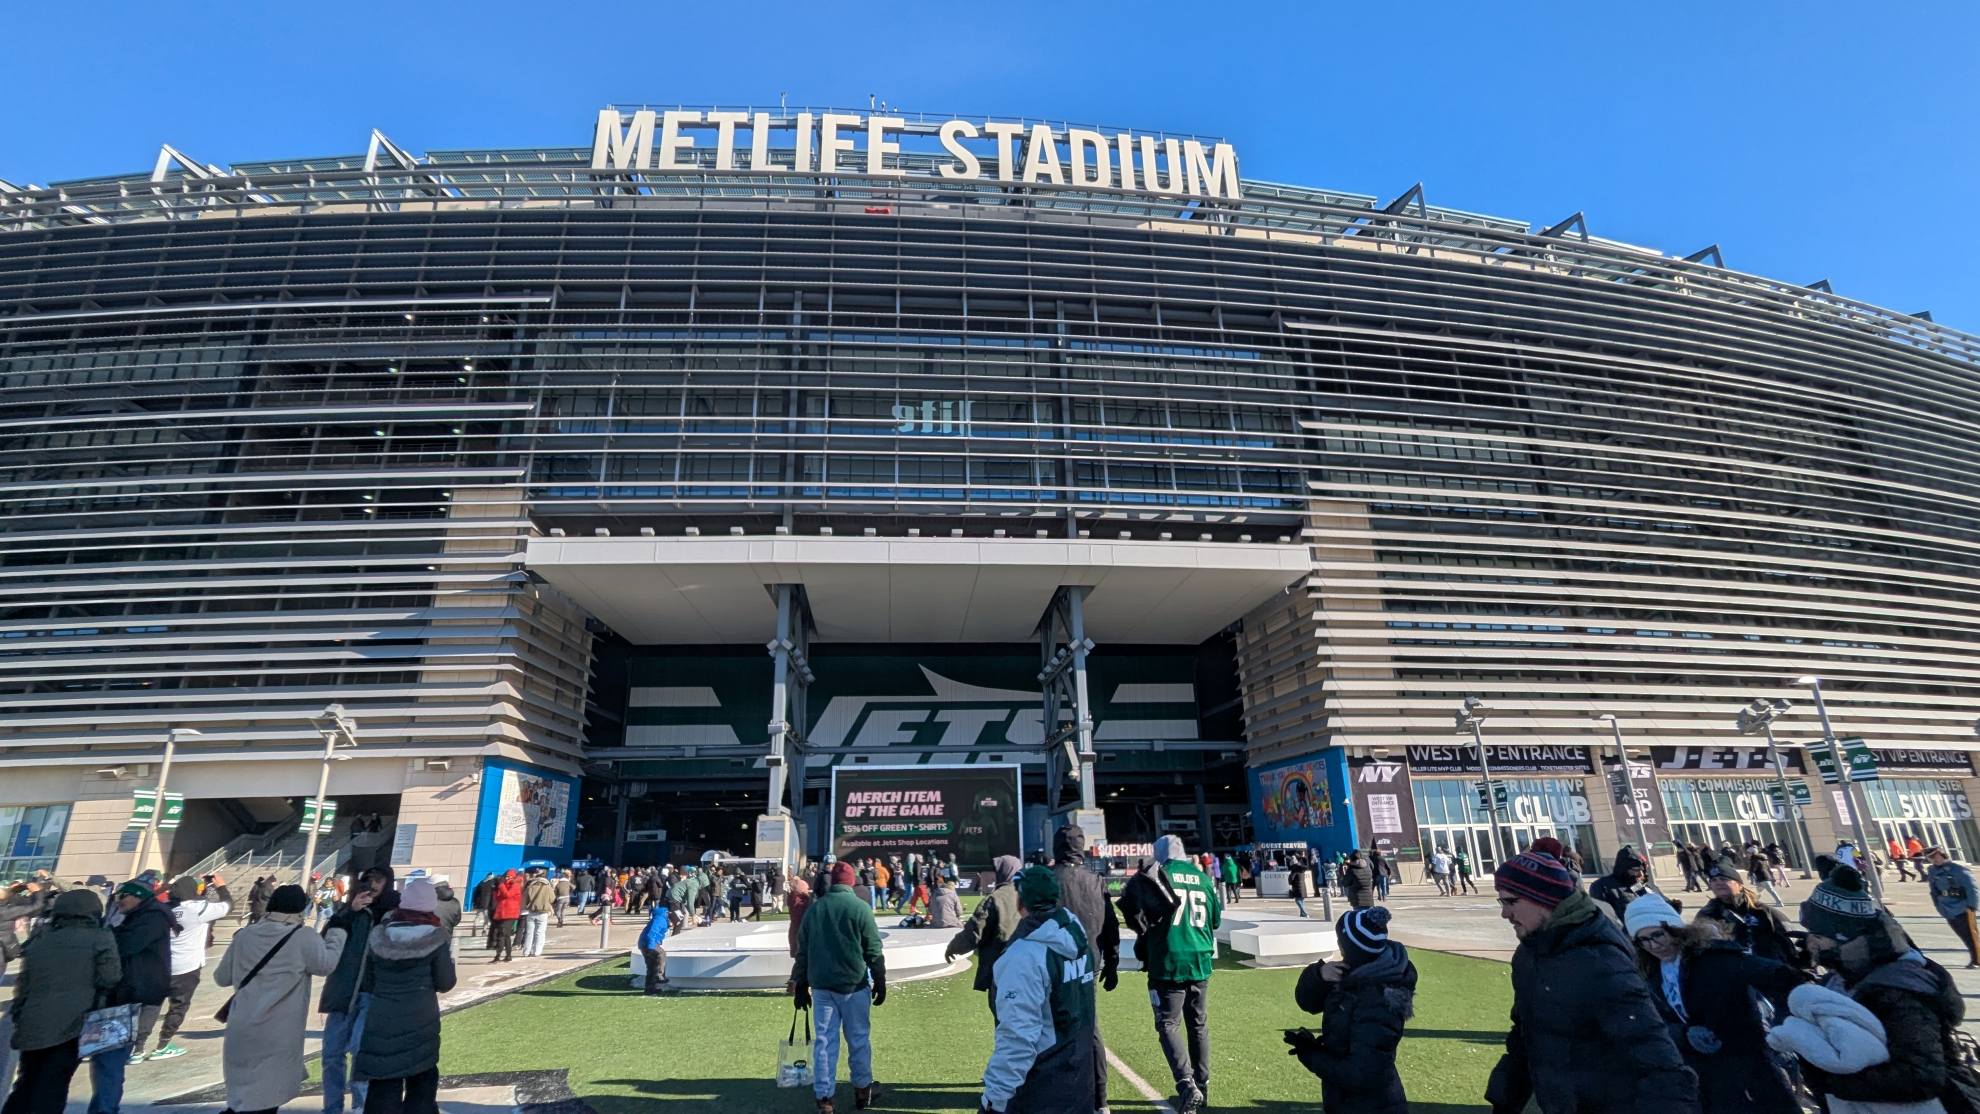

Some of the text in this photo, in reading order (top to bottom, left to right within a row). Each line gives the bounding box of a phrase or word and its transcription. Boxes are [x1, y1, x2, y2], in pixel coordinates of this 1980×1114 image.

[591, 109, 1241, 199] METLIFE STADIUM
[1409, 746, 1586, 760] WEST VP ENTRANCE
[1890, 751, 1908, 762] VIP
[1910, 751, 1969, 764] ENTRANCE
[1358, 765, 1402, 782] NY
[1522, 779, 1552, 792] LITE
[1555, 780, 1584, 792] MVP
[847, 790, 942, 804] MERCH ITEM
[1632, 788, 1648, 798] EST
[845, 804, 945, 818] OF THE GAME
[1514, 796, 1591, 822] CLUB
[1900, 795, 1972, 818] SUITES
[862, 824, 879, 832] OFF
[879, 823, 908, 832] GREEN
[908, 823, 948, 831] T-SHIRTS
[841, 839, 872, 847] Available
[897, 839, 914, 847] Shop
[915, 838, 949, 846] Locations
[1172, 873, 1200, 885] HOLDER
[1173, 889, 1206, 928] 76
